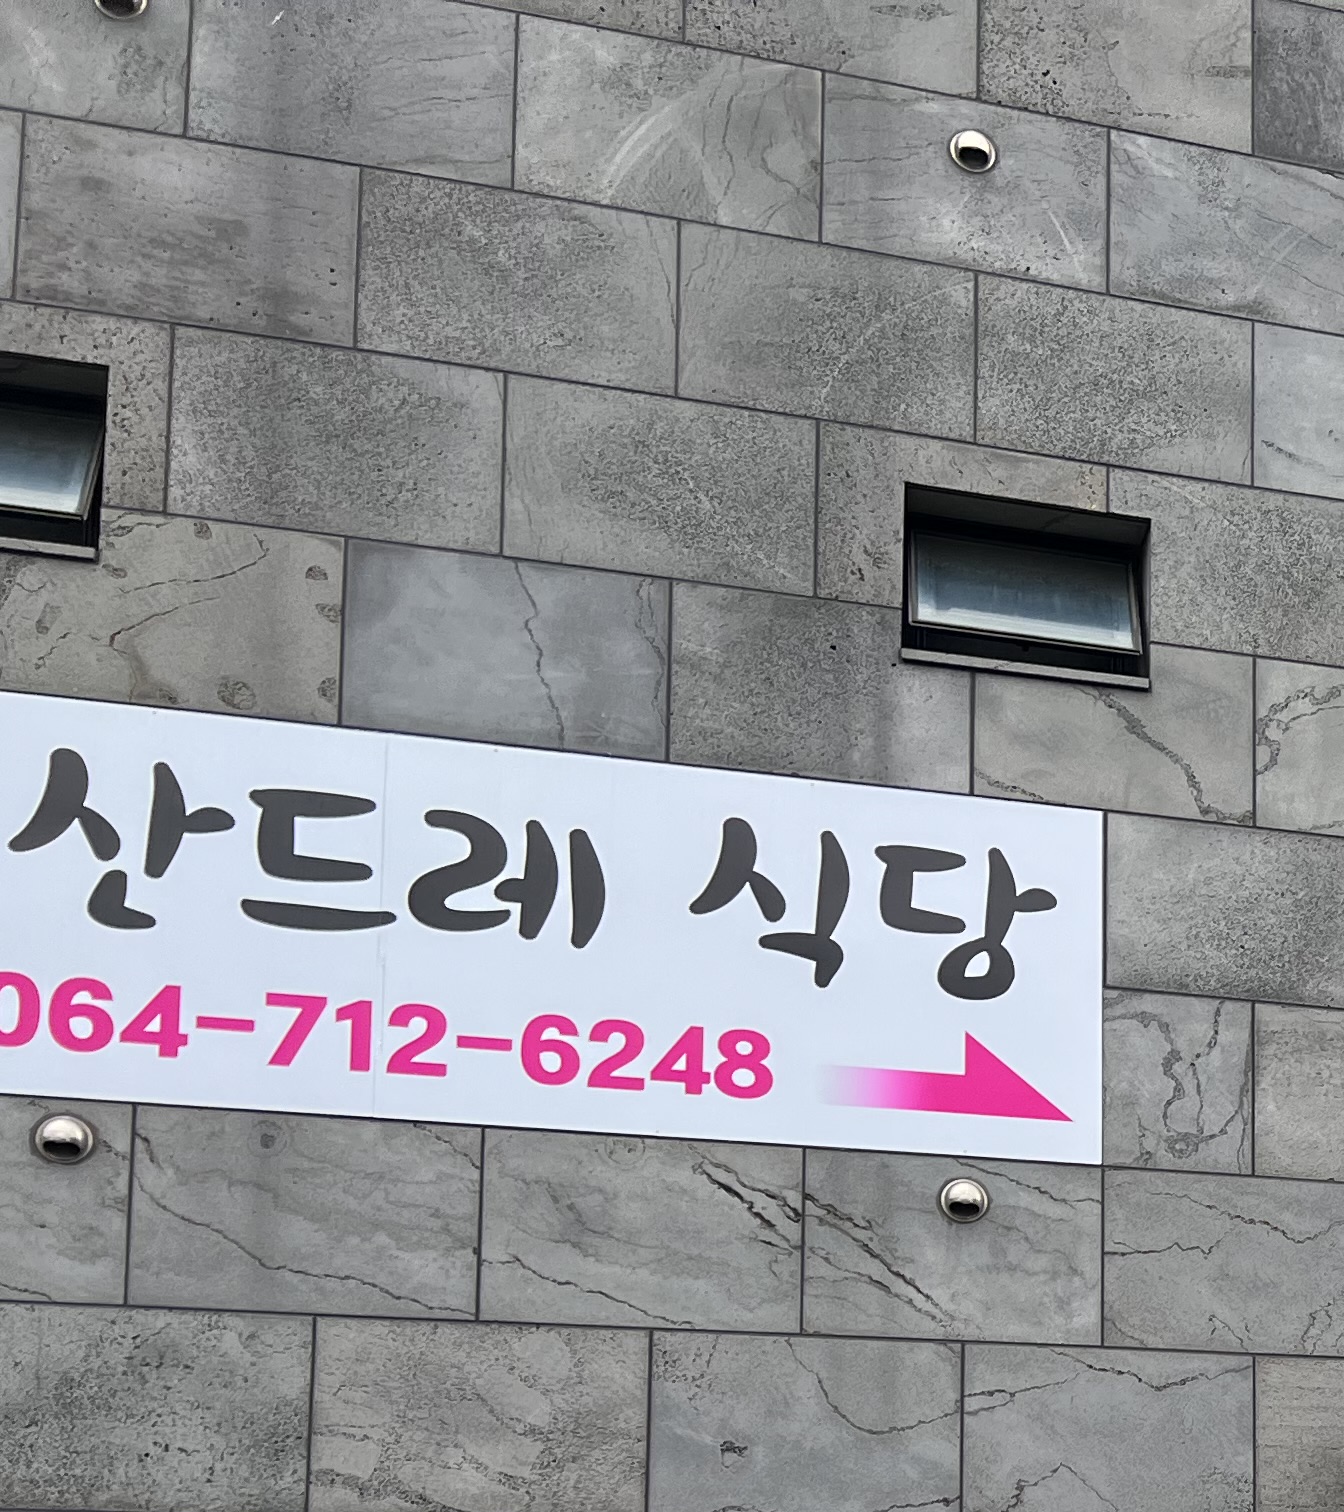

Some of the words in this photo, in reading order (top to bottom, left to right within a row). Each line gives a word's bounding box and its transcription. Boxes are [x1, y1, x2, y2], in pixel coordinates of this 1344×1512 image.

[8, 746, 607, 949] 산드레
[689, 817, 1058, 1000] 식당
[0, 972, 774, 1098] 064-712-6248
